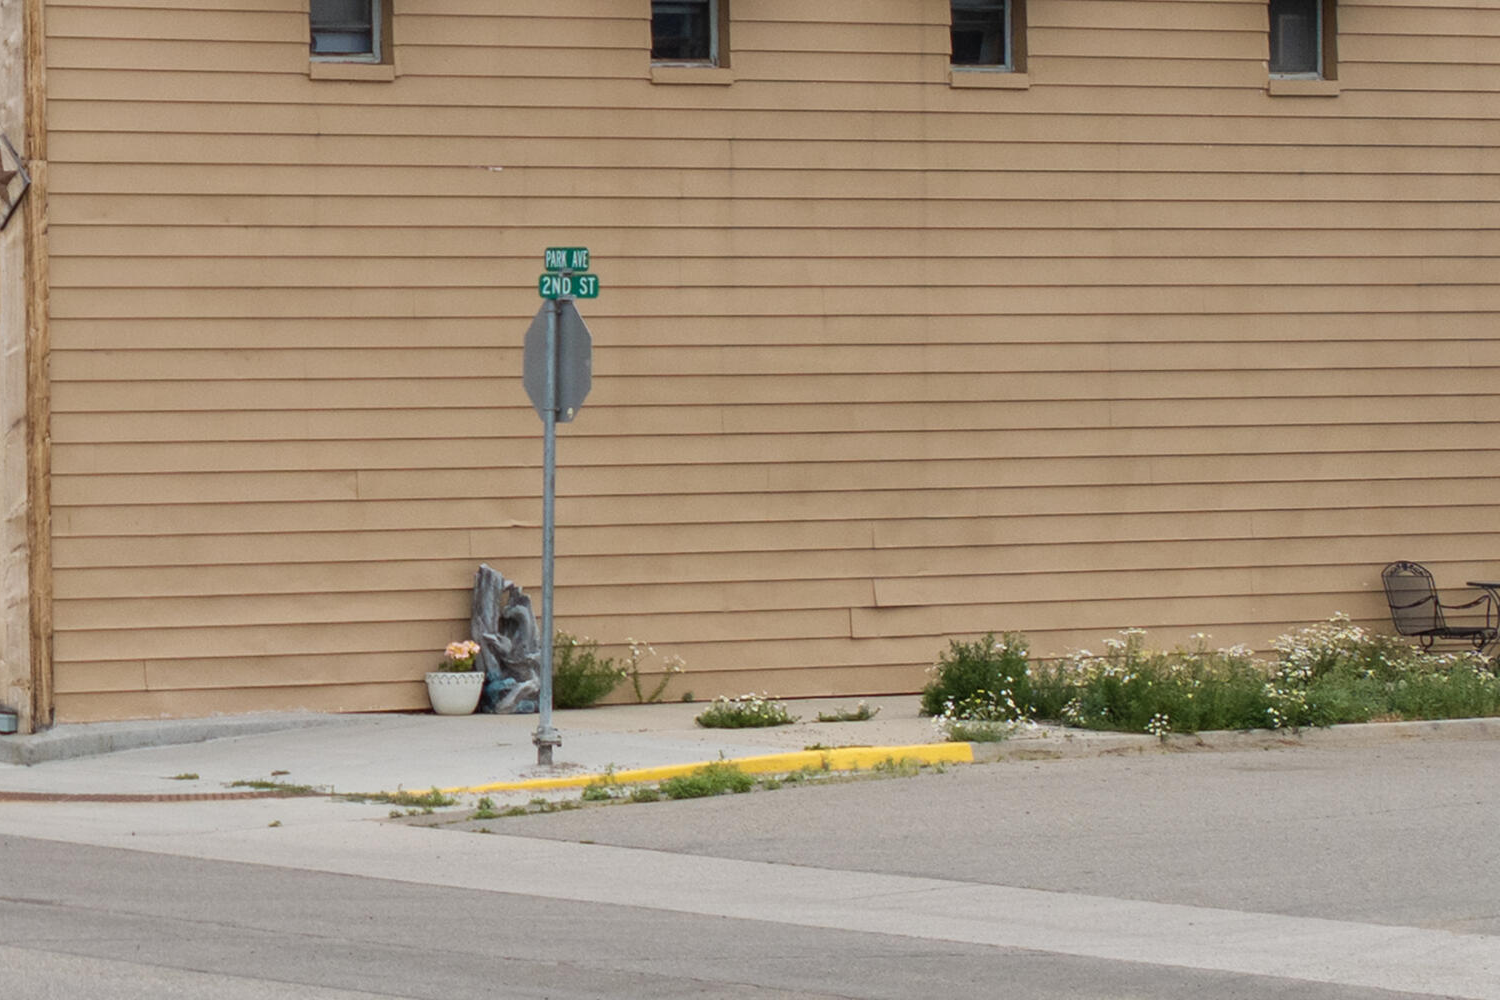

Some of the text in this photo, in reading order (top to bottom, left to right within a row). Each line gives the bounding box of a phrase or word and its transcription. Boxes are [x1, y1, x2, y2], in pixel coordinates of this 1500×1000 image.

[545, 250, 589, 268] PARK AVE
[542, 276, 596, 295] 2ND ST
